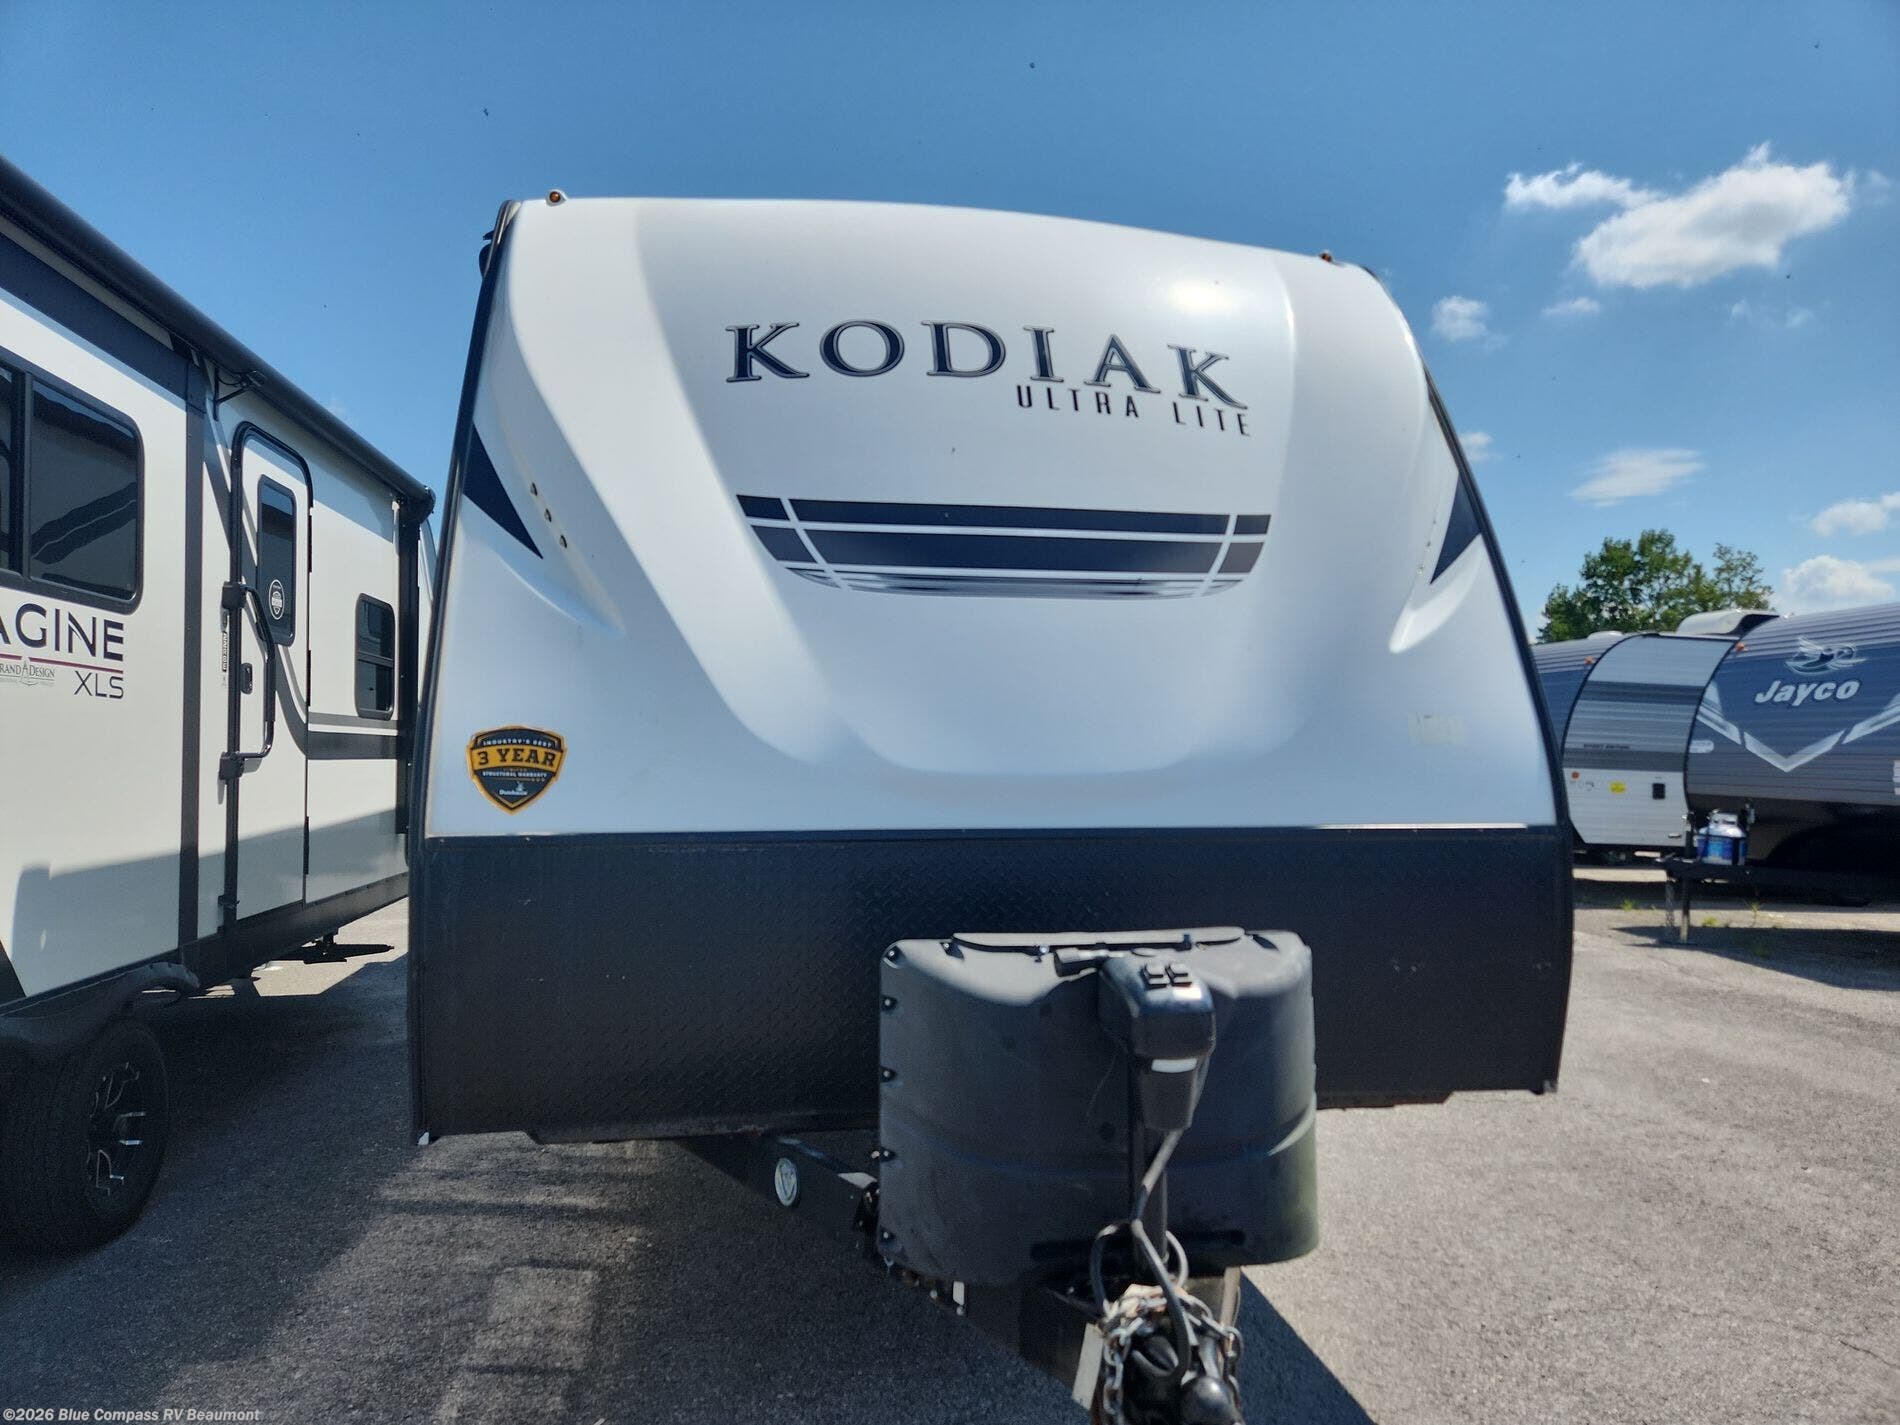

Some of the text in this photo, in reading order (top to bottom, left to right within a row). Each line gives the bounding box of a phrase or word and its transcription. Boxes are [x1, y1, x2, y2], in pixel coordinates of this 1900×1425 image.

[725, 320, 1248, 410] KODIAK
[1016, 384, 1251, 437] ULTRA LITE
[74, 670, 124, 699] XLS
[1754, 679, 1861, 707] Jayco
[477, 748, 556, 767] 3 YEAR
